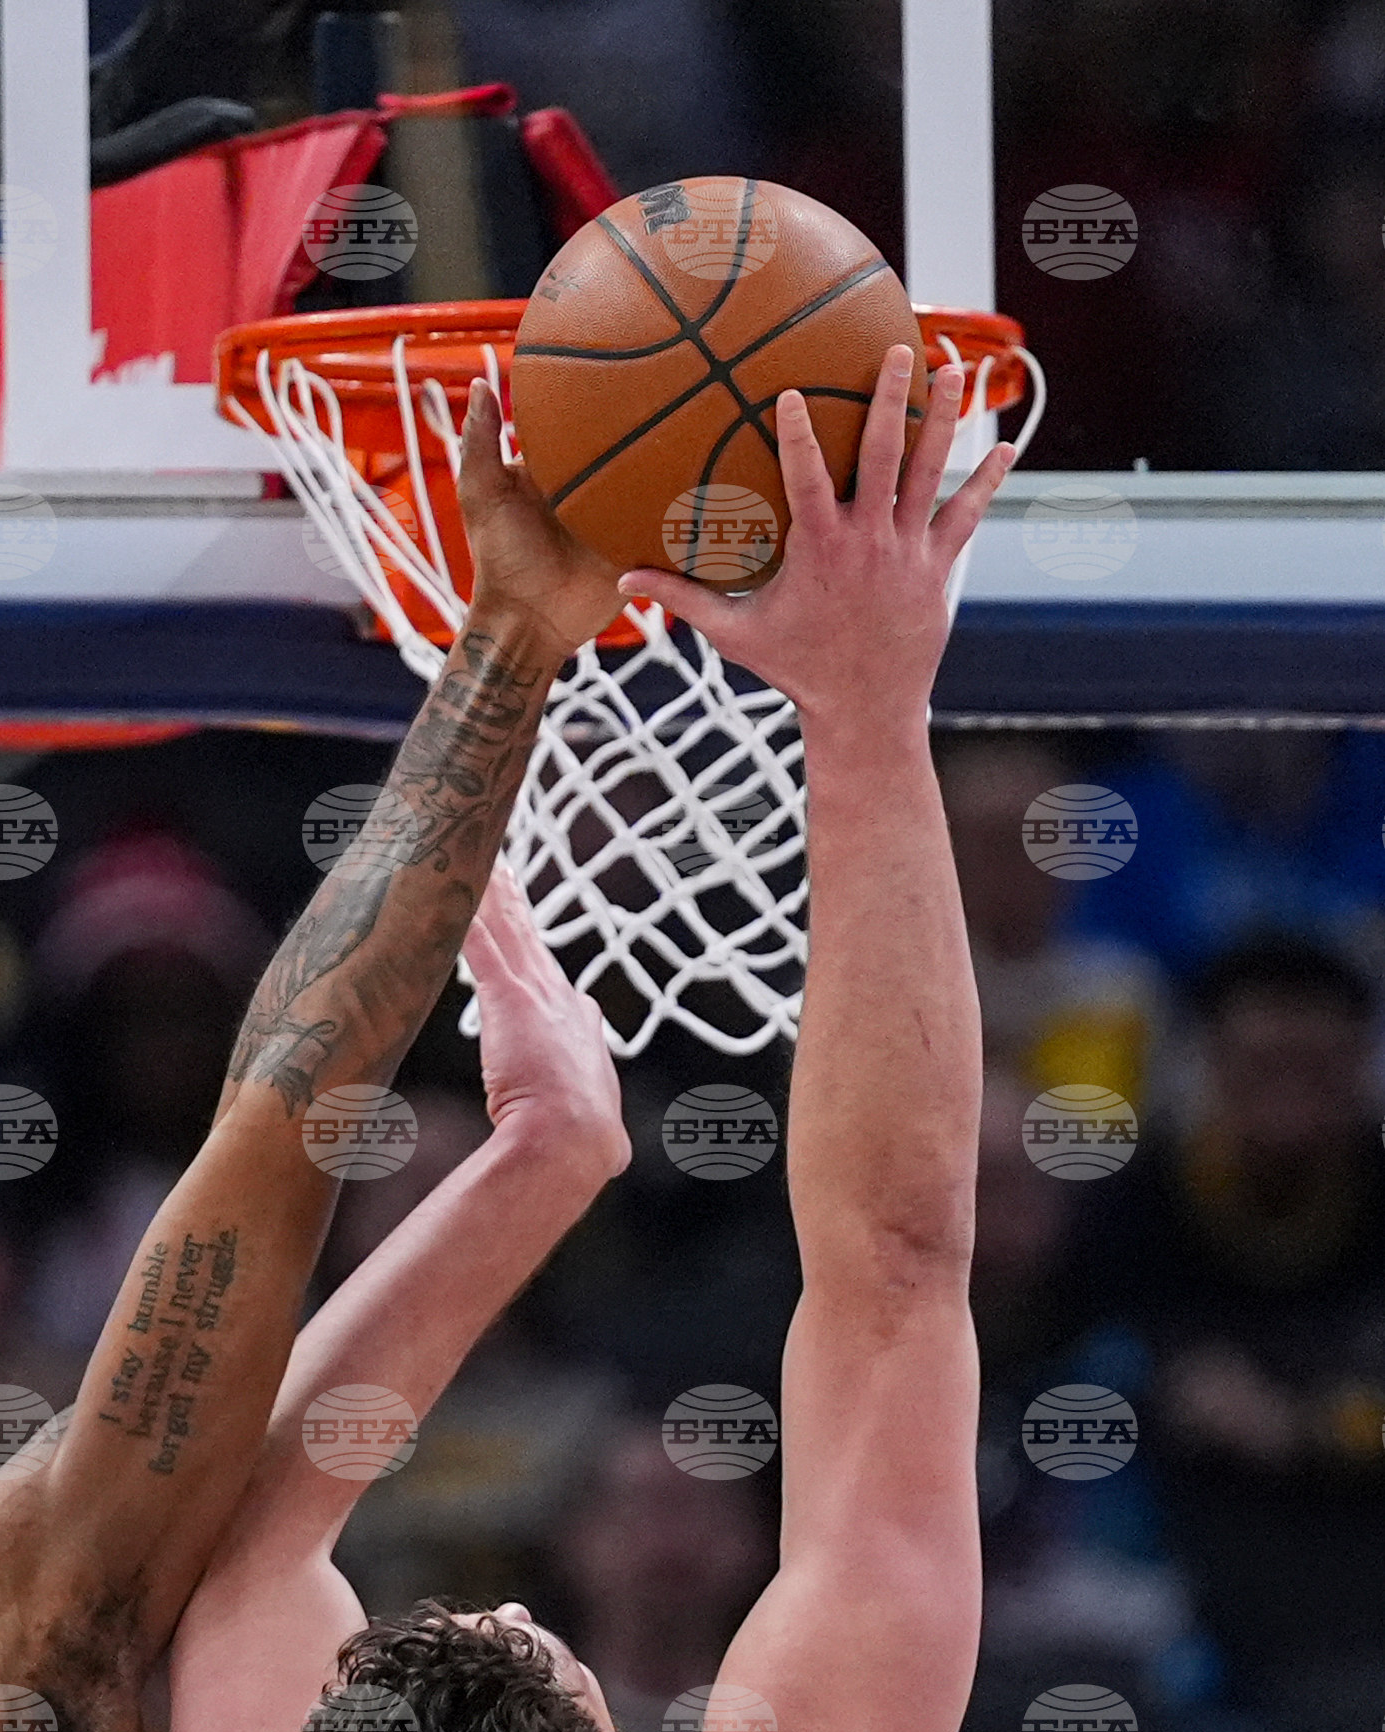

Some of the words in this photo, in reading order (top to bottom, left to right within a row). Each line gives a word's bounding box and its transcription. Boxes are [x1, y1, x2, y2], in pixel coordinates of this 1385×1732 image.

[126, 1334, 182, 1437] because
[169, 1233, 205, 1310] never
[127, 1240, 168, 1335] humble
[111, 1347, 144, 1403] stay
[148, 1393, 195, 1475] forget
[180, 1341, 212, 1384] my
